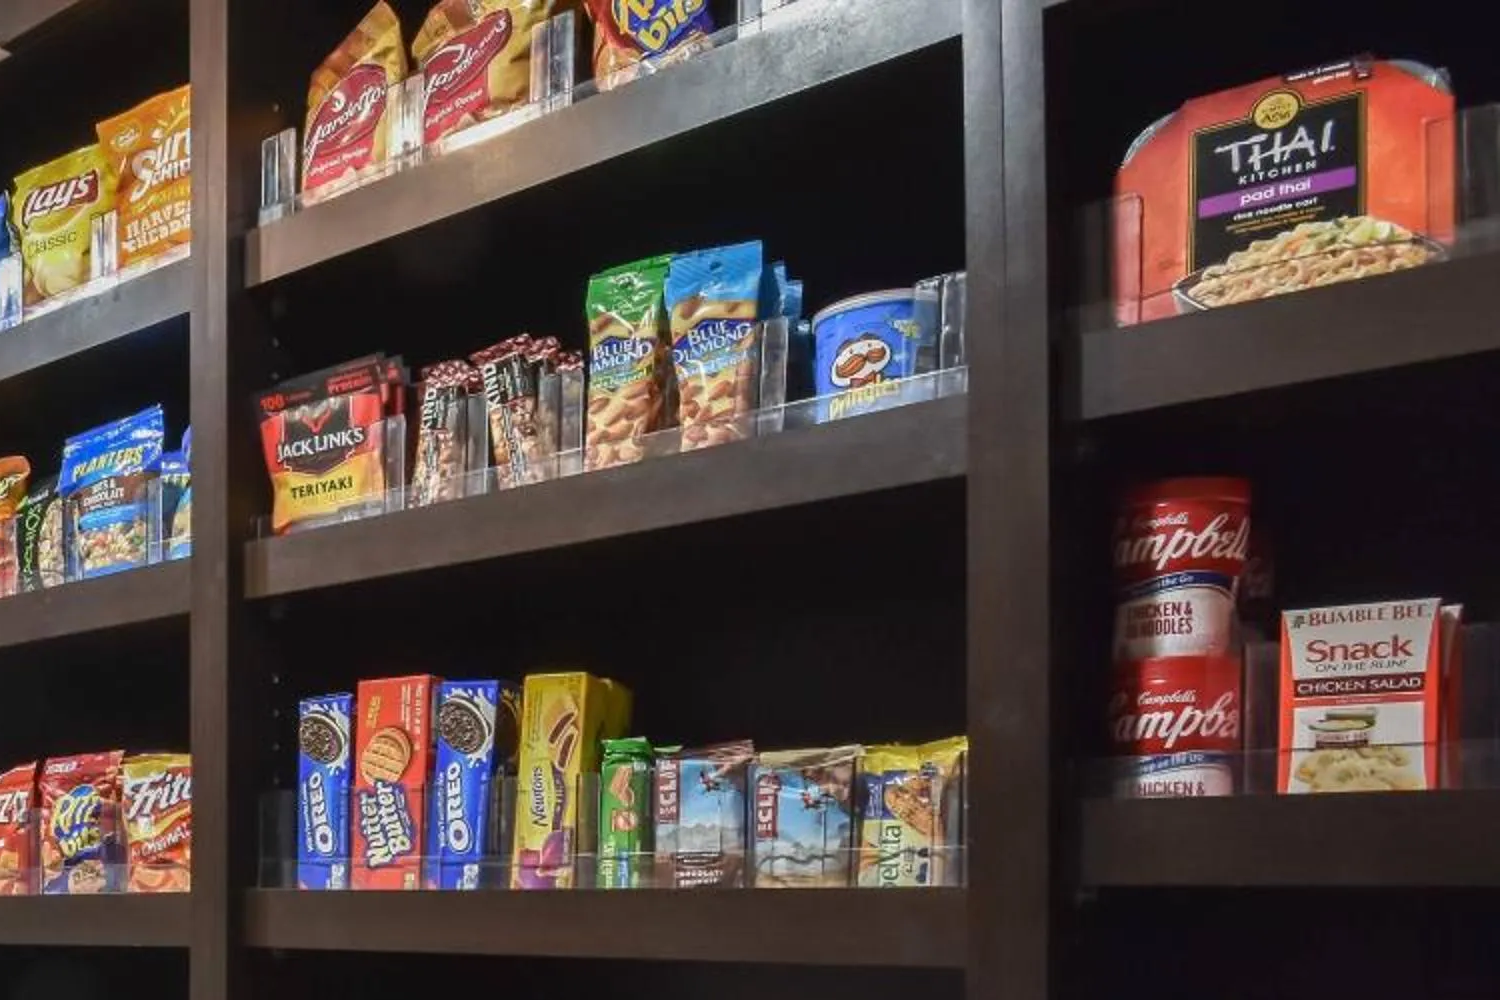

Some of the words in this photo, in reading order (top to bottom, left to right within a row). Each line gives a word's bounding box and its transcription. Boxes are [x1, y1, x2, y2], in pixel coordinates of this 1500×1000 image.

[1214, 119, 1333, 173] THAI
[1238, 160, 1317, 185] KITCHEN
[1240, 187, 1275, 207] pad
[1279, 177, 1311, 195] thai
[126, 200, 190, 238] HARVE
[688, 321, 727, 346] BLUE
[484, 363, 501, 410] KIND
[278, 438, 315, 463] JACK
[291, 475, 353, 500] TERIYAKI
[1114, 512, 1250, 571] ampbell
[1308, 607, 1387, 627] BUMBLE
[1393, 603, 1428, 621] BEE
[1305, 634, 1413, 663] Snack
[1297, 680, 1366, 694] CHICKEN
[1370, 677, 1421, 690] SALAD
[309, 771, 333, 853] OREO
[447, 761, 470, 853] OREO
[530, 767, 549, 827] Newtons
[881, 825, 902, 888] elVita
